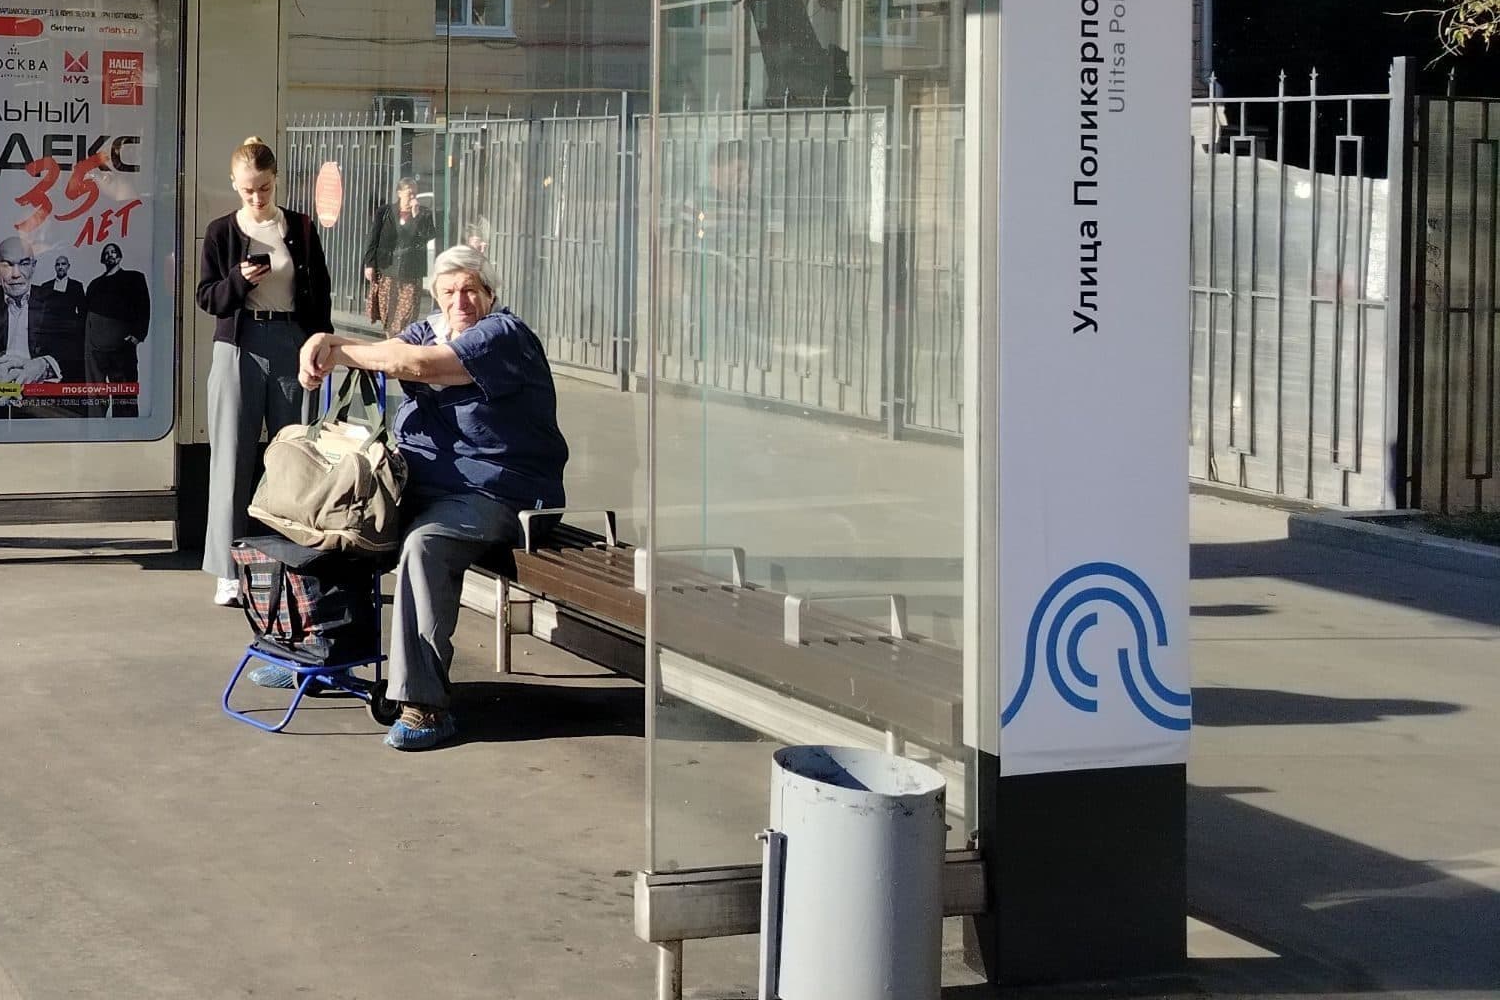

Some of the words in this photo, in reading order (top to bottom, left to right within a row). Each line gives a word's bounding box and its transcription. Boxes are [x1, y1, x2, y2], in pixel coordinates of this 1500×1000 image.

[50, 23, 86, 33] билеты
[109, 58, 138, 70] НАШЕ
[1108, 42, 1126, 114] Ulitsa
[14, 151, 111, 231] 35
[74, 199, 143, 248] ЛЕТ
[1072, 219, 1102, 334] Улица
[61, 384, 136, 394] moscow-hall.ru
